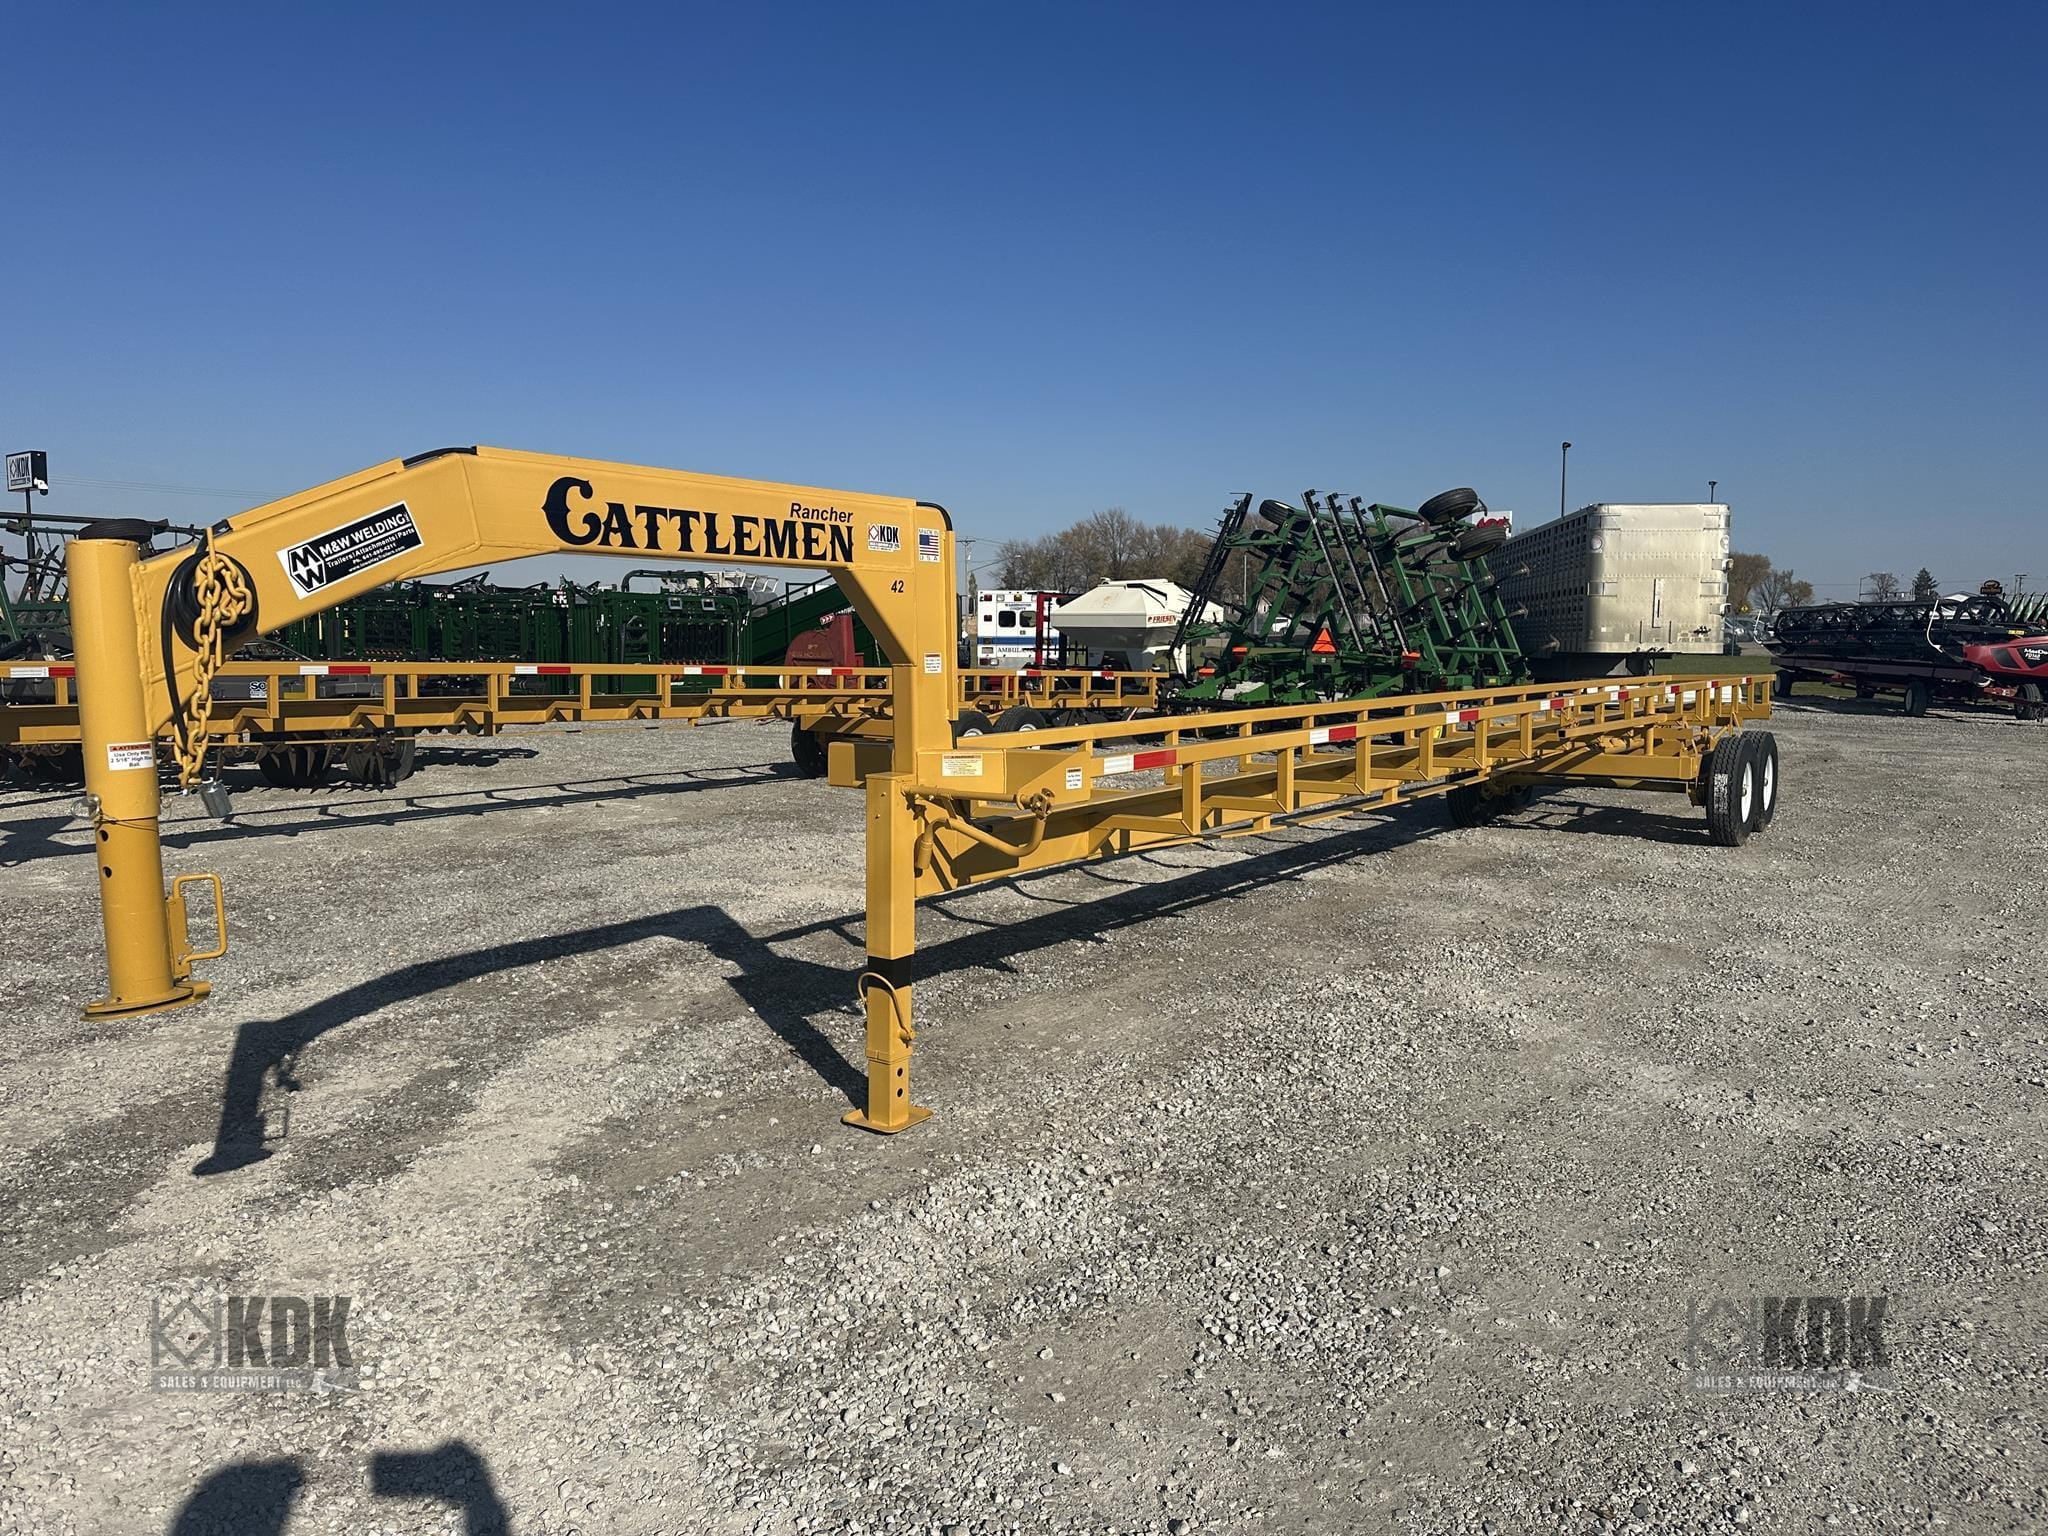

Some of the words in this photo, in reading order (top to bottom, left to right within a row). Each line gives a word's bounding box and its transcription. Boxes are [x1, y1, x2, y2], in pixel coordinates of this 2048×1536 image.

[790, 502, 854, 523] Rancher
[319, 536, 350, 557] M&W
[351, 514, 406, 544] WELDING
[880, 525, 899, 543] KDK
[327, 553, 352, 568] Trailers
[355, 536, 395, 556] Attachments
[398, 528, 414, 538] Parts
[891, 580, 904, 593] 42
